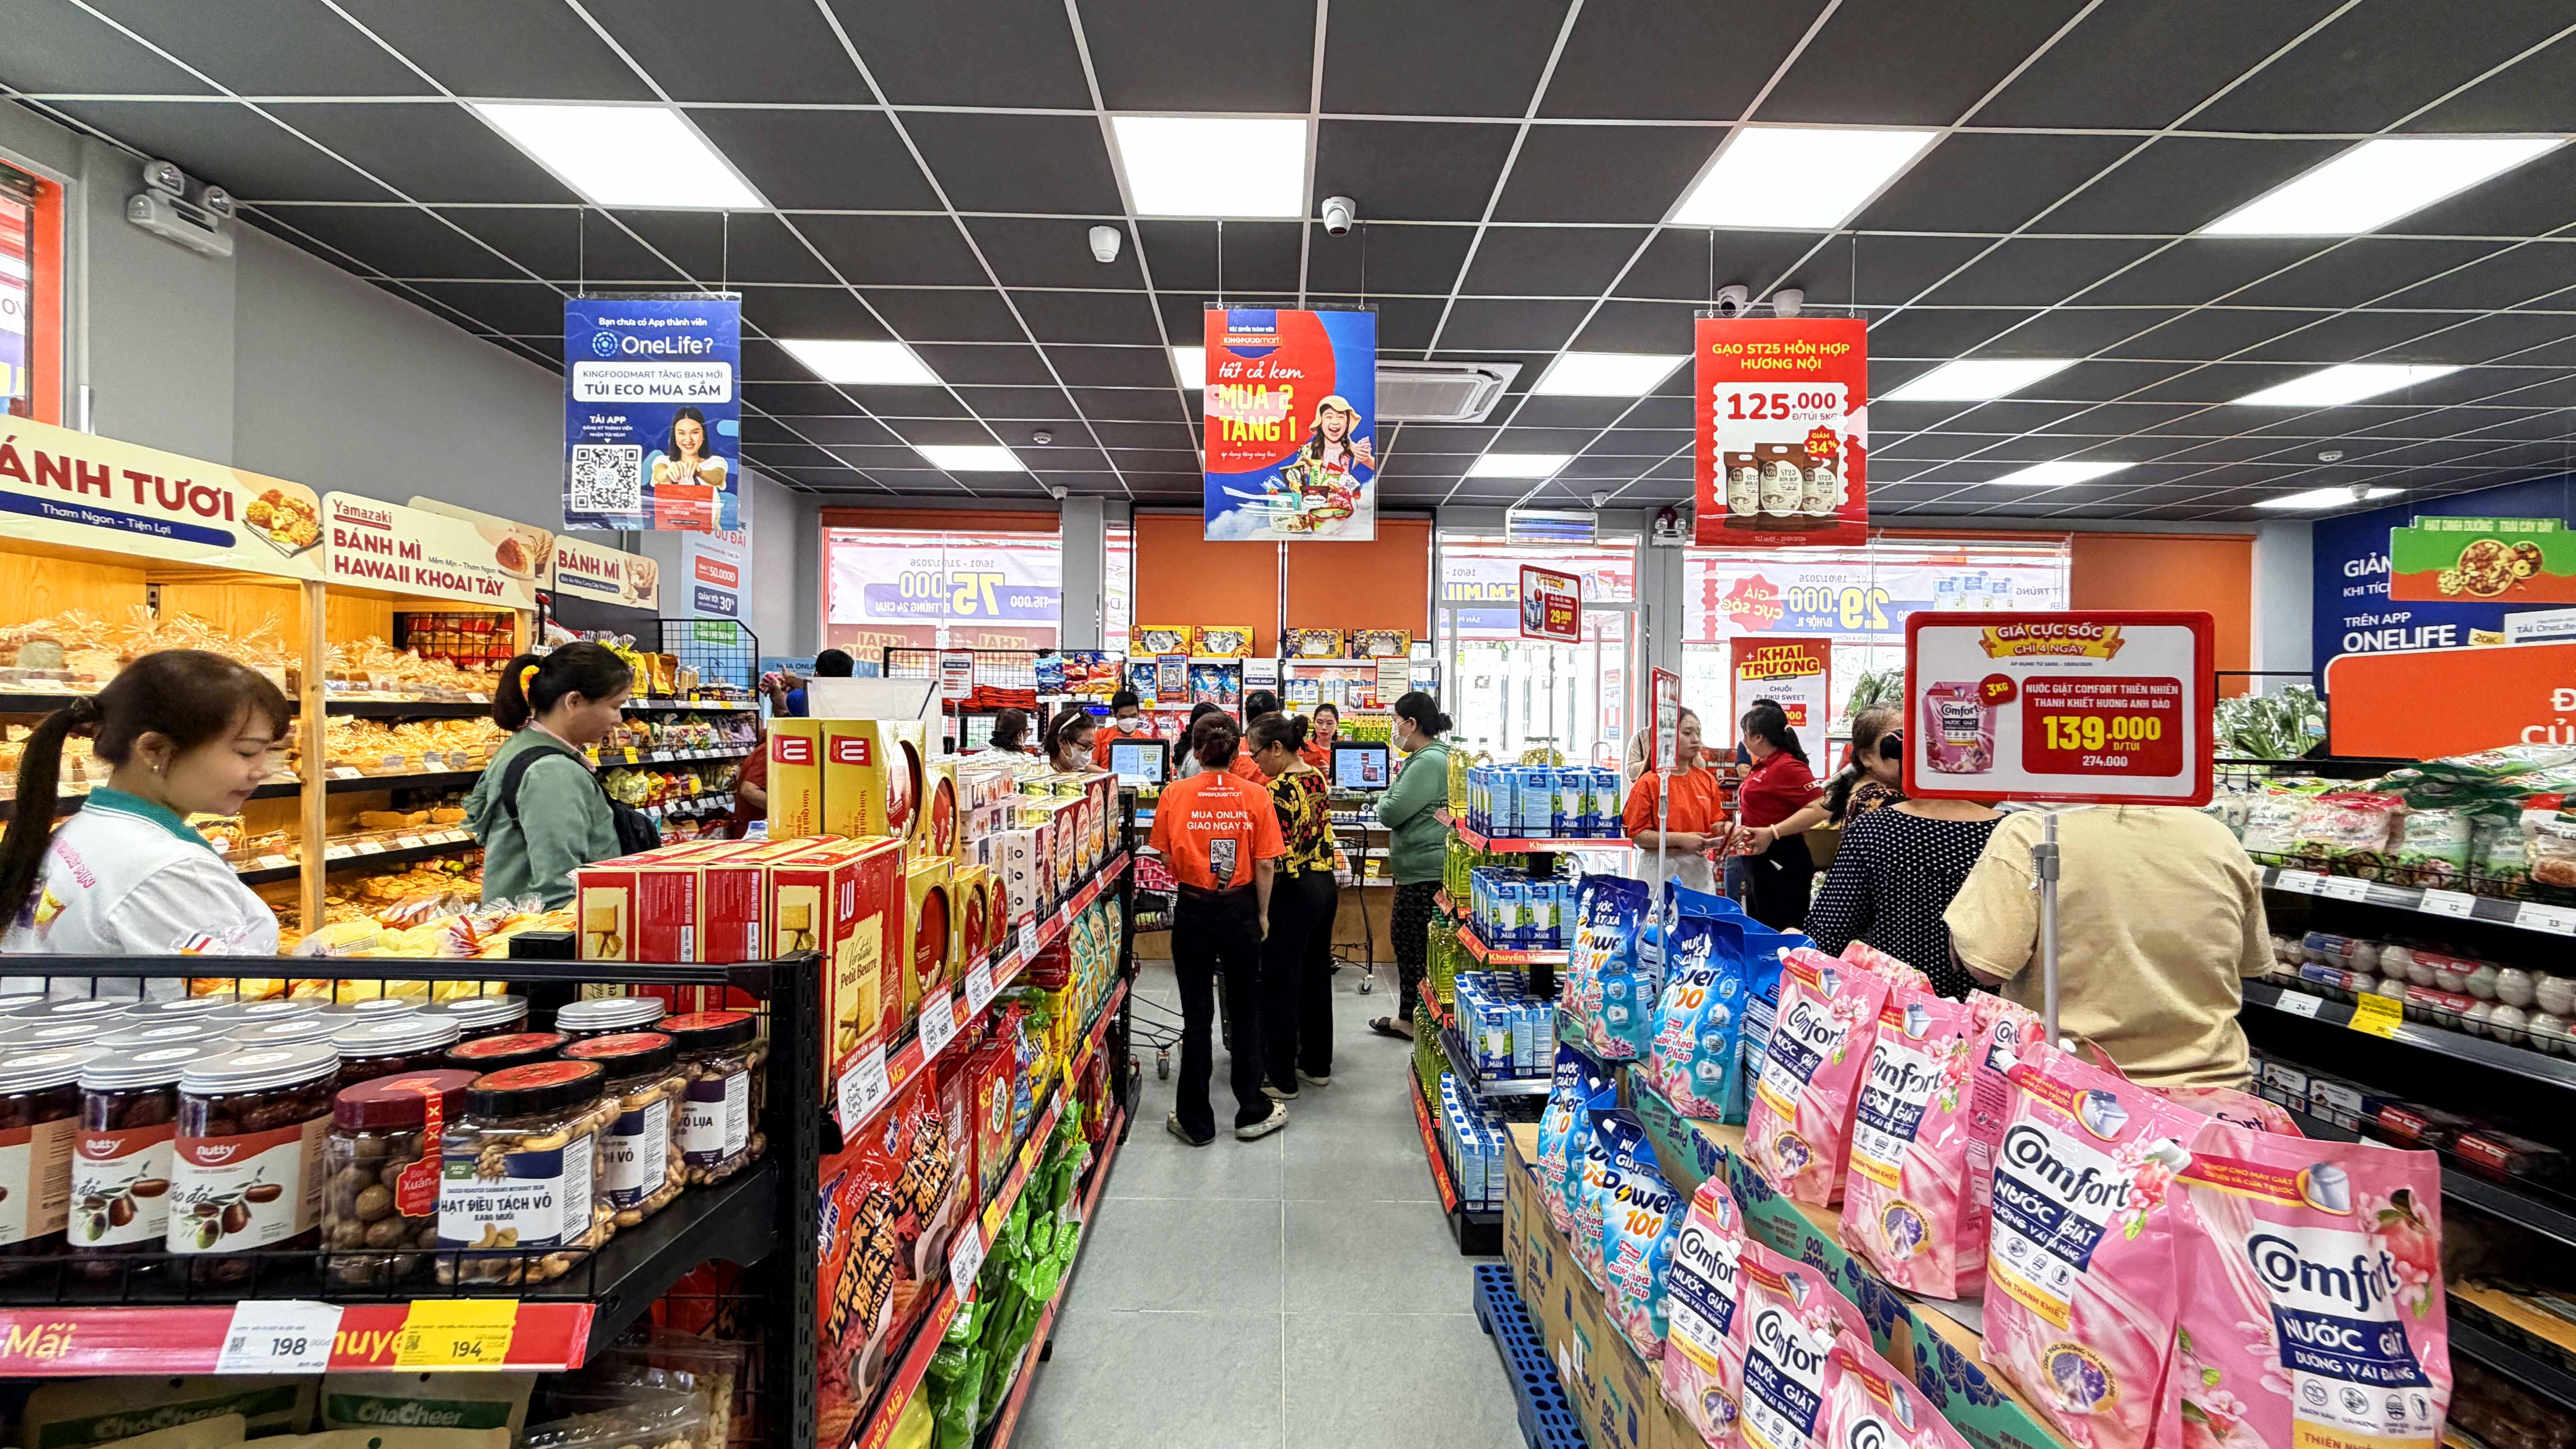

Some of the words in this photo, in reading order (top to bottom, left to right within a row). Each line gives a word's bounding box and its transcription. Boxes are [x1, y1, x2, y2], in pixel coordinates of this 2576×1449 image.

[599, 317, 615, 327] Bạn
[637, 317, 647, 327] có
[649, 318, 665, 327] App
[690, 317, 708, 326] viên
[621, 335, 714, 354] OneLife?
[1712, 344, 1743, 357] GẠO
[1747, 344, 1781, 354] ST25
[1785, 339, 1817, 354] HỖN
[1820, 342, 1850, 358] HỢP
[1246, 361, 1265, 379] cả
[1269, 362, 1305, 380] kem
[1740, 357, 1793, 369] HƯƠNG
[1796, 356, 1822, 372] NỘI
[583, 370, 656, 379] KINGFOODMART
[658, 369, 683, 382] TẶNG
[684, 370, 704, 381] BẠN
[705, 368, 723, 379] MỚI
[584, 382, 610, 396] TÚI
[614, 384, 644, 396] ECO
[649, 384, 684, 396] MUA
[688, 380, 721, 396] SẮM
[1219, 384, 1269, 410] MUA
[1278, 384, 1294, 410] 2
[1727, 392, 1837, 421] 125.000
[589, 413, 605, 424] TẢI
[607, 415, 627, 424] APP
[1219, 410, 1281, 447] TẶNG
[1288, 416, 1297, 442] 1
[1811, 430, 1830, 439] GIẢM
[1808, 440, 1838, 454] 34%
[0, 434, 112, 500] ÁNH
[122, 468, 235, 522] TƯƠI
[39, 502, 79, 521] Thơm
[81, 508, 115, 527] Ngon
[126, 517, 152, 533] Tiện
[154, 522, 171, 536] Lợi
[333, 499, 392, 525] Yamazaki
[333, 525, 394, 556] BÁNH
[399, 539, 422, 561] MÌ
[558, 548, 600, 575] BÁNH
[604, 558, 620, 580] MÌ
[334, 554, 410, 584] HAWAII
[416, 568, 472, 593] KHOAI
[476, 574, 505, 597] TÂY
[2343, 587, 2364, 598] KHI
[2343, 612, 2379, 628] TRÊN
[2381, 612, 2411, 625] APP
[1997, 622, 2026, 639] GIÁ
[2030, 622, 2067, 639] CỰC
[2068, 621, 2103, 638] SỐC
[2343, 624, 2457, 652] ONELIFE
[2474, 634, 2498, 644] 20K
[1759, 647, 1803, 661] KHAI
[2014, 643, 2036, 654] CHỈ
[2038, 644, 2047, 653] 4
[2050, 642, 2087, 654] NGÀY
[1742, 658, 1819, 676] TRƯƠNG
[1987, 682, 2009, 697] 3KG
[2026, 683, 2050, 694] NƯỚC
[2052, 684, 2073, 696] GIẶT
[2075, 684, 2118, 695] COMFORT
[2120, 683, 2148, 695] THIÊN
[2150, 684, 2179, 695] NHIÊN
[1941, 702, 1979, 718] Comfort
[2034, 698, 2065, 708] THANH
[2067, 695, 2094, 708] KHIẾT
[2130, 699, 2149, 708] ANH
[2042, 715, 2161, 751] 139.000
[782, 739, 807, 761] LU
[840, 740, 865, 761] LU
[1191, 811, 1213, 819] MUA
[1216, 811, 1249, 819] ONLINE
[1561, 819, 1578, 828] Milk
[1597, 819, 1614, 828] Milk
[1187, 822, 1211, 830] GIAO
[1213, 822, 1241, 830] NGAY
[840, 879, 855, 922] LU
[1500, 931, 1517, 939] Milk
[1489, 952, 1525, 962] Khuyến
[840, 970, 856, 989] Petit
[856, 958, 878, 981] Beurre
[1788, 1001, 1846, 1046] Comfort
[1488, 1059, 1504, 1068] Milk
[889, 1061, 906, 1087] Mãi
[693, 1116, 713, 1129] LỤA
[196, 1144, 238, 1163] nutty
[2003, 1125, 2131, 1210] Comfort
[1602, 1170, 1675, 1215] Power
[441, 1199, 465, 1215] HẠT
[467, 1196, 493, 1211] ĐIỀU
[497, 1194, 529, 1210] TÁCH
[533, 1191, 552, 1209] VỎ
[1624, 1210, 1663, 1239] 100
[2247, 1233, 2400, 1313] Comfort
[1621, 1279, 1649, 1299] Pháp
[1672, 1268, 1705, 1299] NƯỚC
[1707, 1291, 1731, 1317] GIẶT
[2013, 1282, 2039, 1305] THANH
[2040, 1296, 2067, 1320] KHIẾT
[6, 1322, 78, 1362] Mãi
[2281, 1316, 2366, 1352] NƯỚC
[271, 1337, 307, 1357] 198
[451, 1340, 483, 1359] 194
[2294, 1350, 2344, 1373] DƯỠNG
[2346, 1361, 2379, 1380] VẢI
[1783, 1382, 1816, 1414] GIẶT
[358, 1397, 468, 1427] ChaCheer
